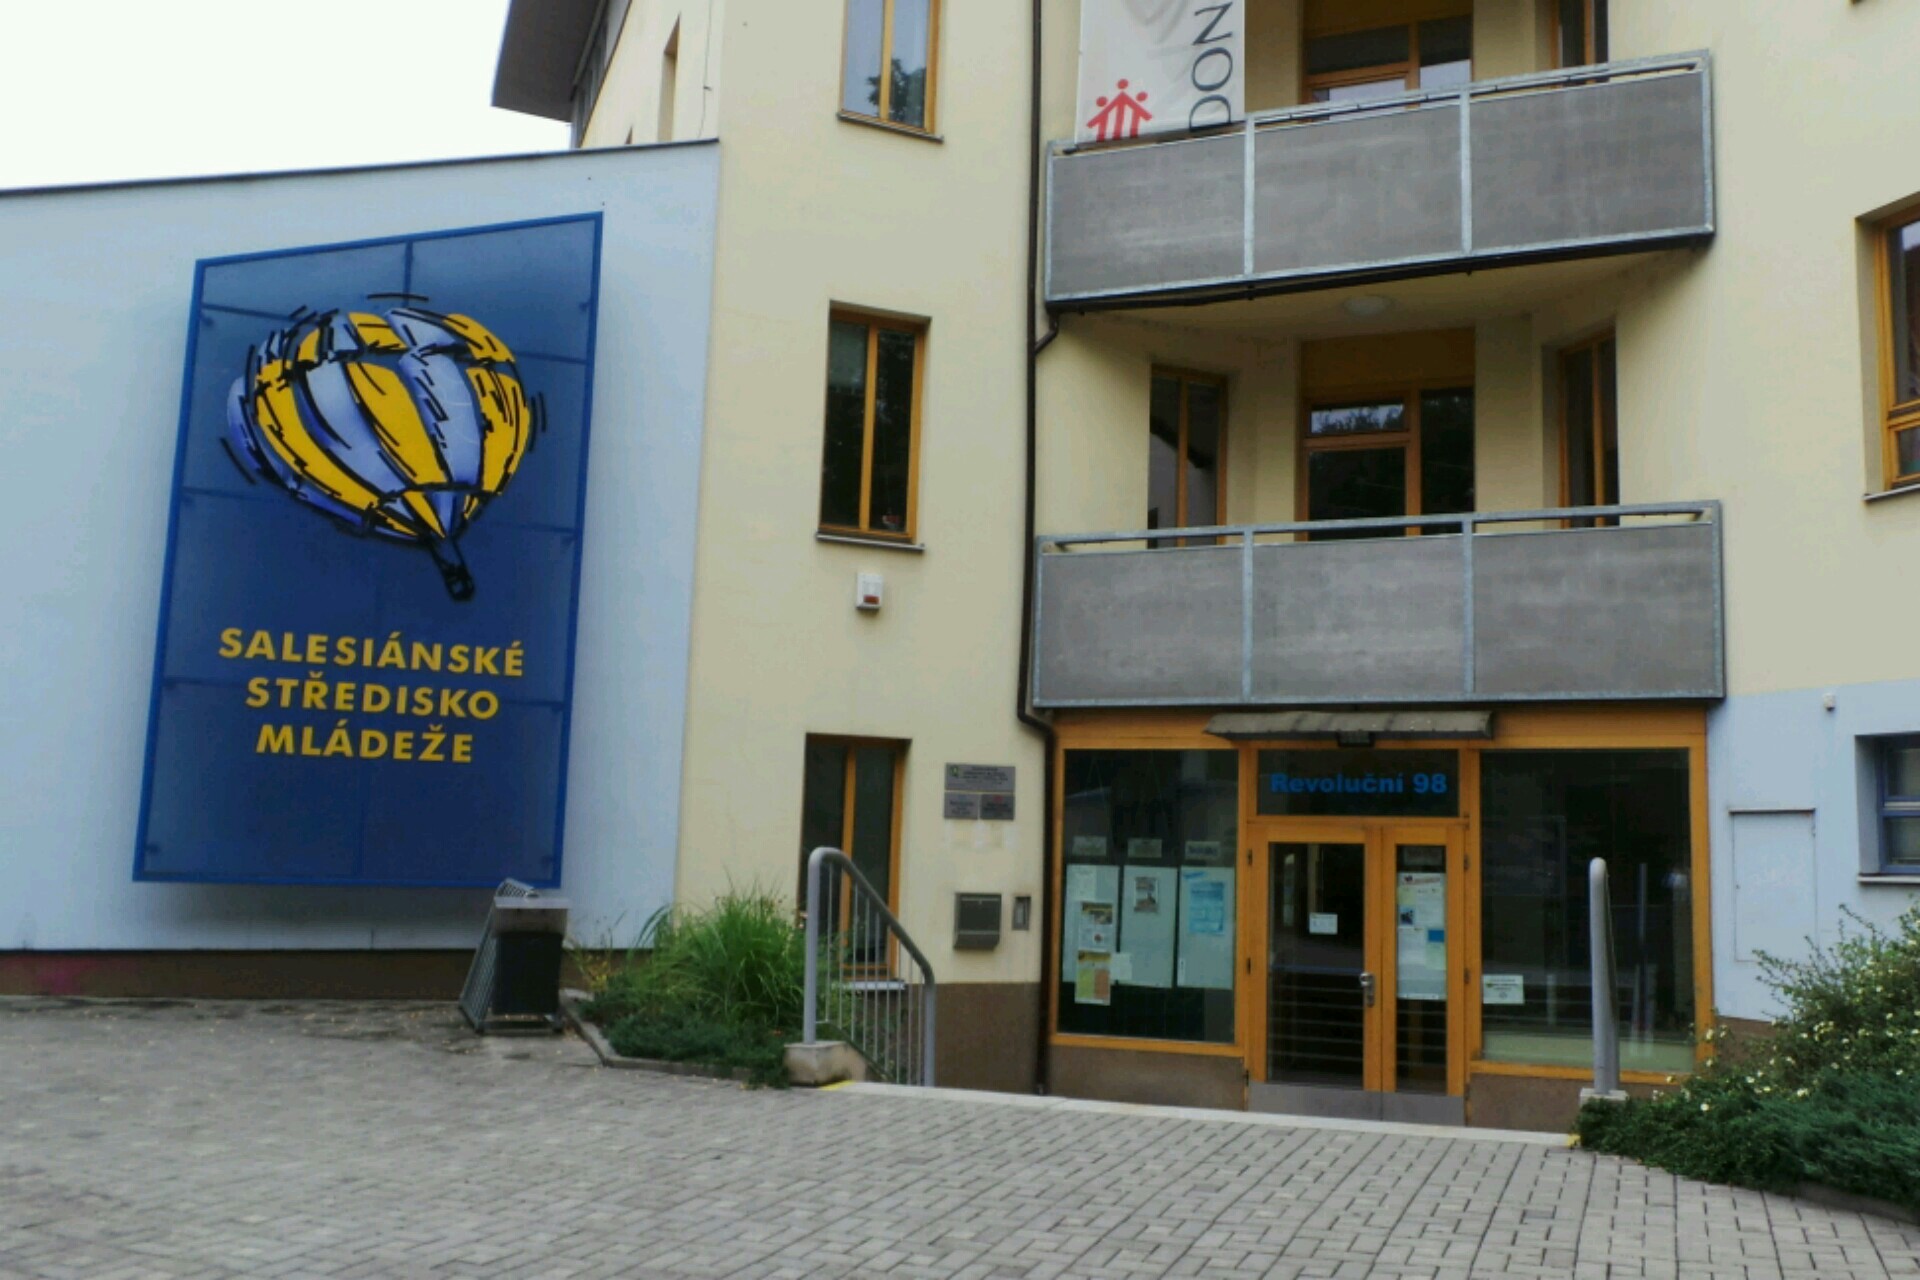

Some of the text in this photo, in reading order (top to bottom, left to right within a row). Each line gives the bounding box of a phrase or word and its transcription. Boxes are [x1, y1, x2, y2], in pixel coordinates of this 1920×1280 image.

[1189, 1, 1233, 133] DON
[218, 627, 525, 677] SALESIÁNSKÉ
[245, 671, 499, 720] STŘEDISKO
[256, 719, 473, 763] MLÁDEŽE
[1270, 771, 1448, 794] Revoluční 98
